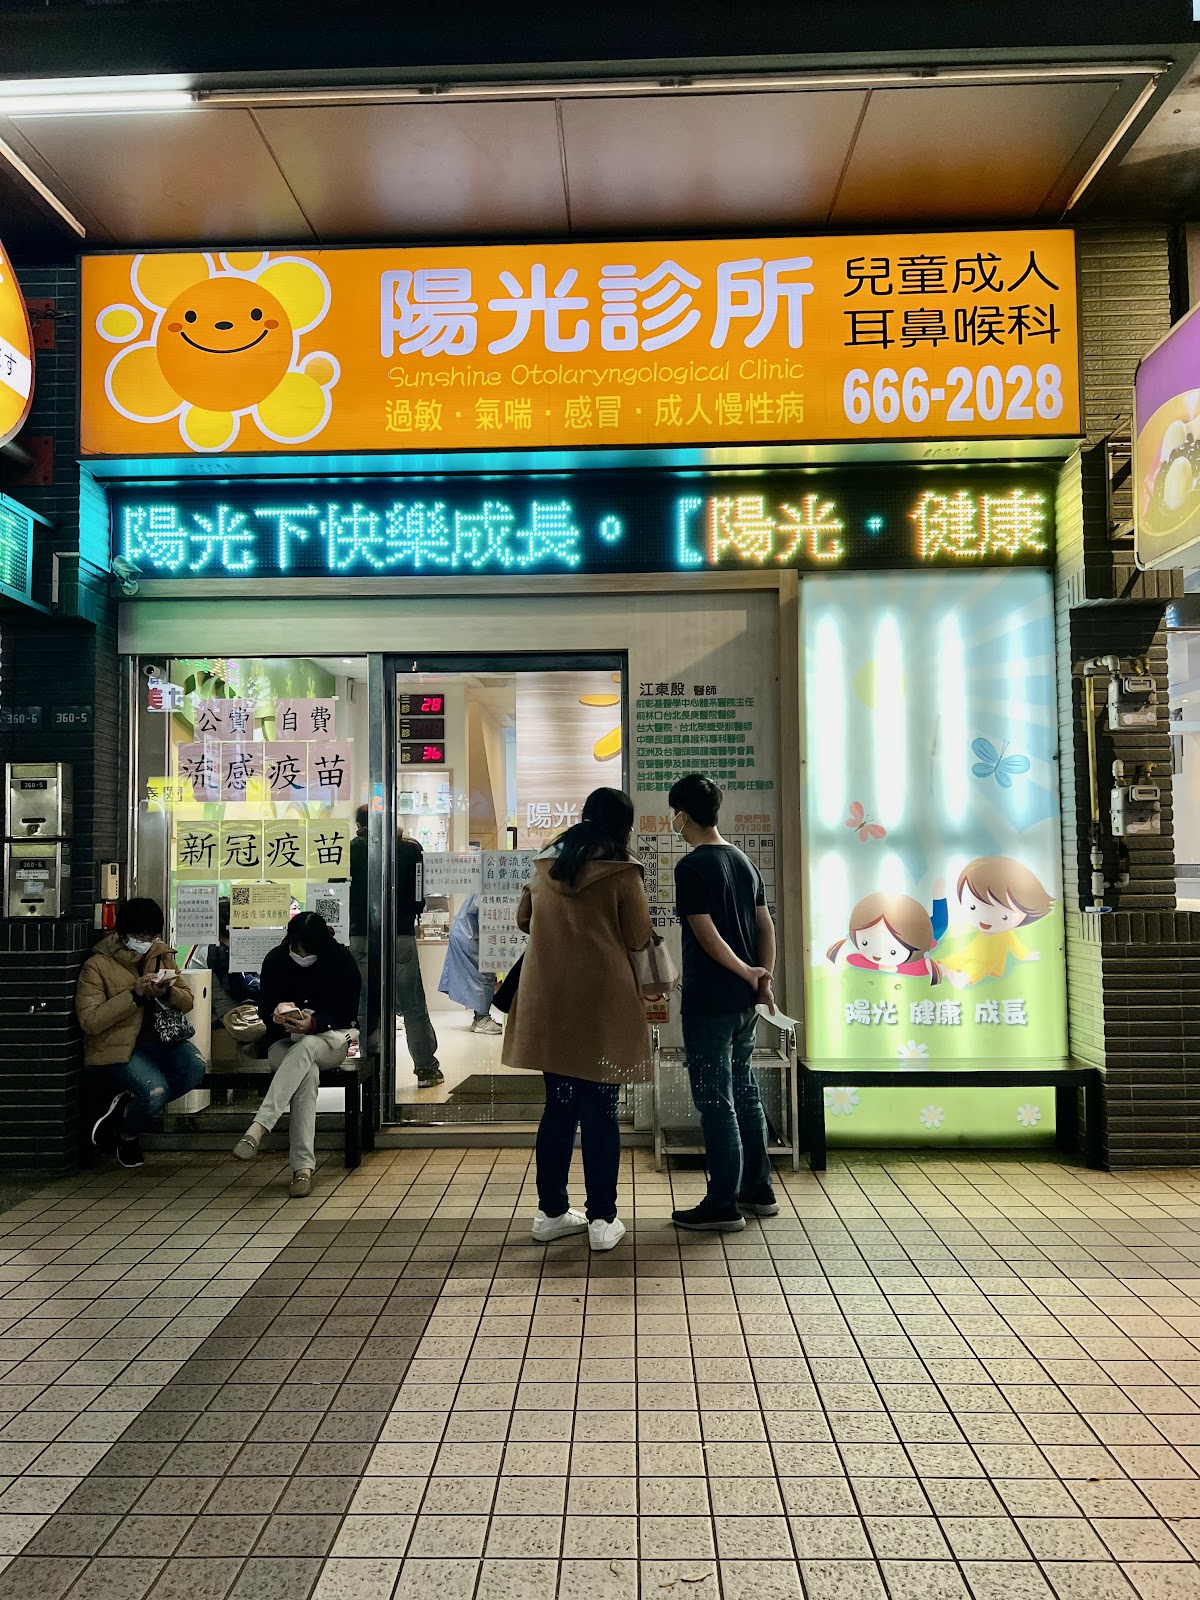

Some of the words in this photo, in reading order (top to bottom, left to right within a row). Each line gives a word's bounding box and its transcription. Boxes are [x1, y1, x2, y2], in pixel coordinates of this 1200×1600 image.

[843, 250, 1060, 298] 兒童成人
[380, 256, 814, 358] 陽光診所
[843, 304, 1061, 350] 耳鼻喉科
[389, 366, 501, 387] Sunshine
[511, 359, 729, 386] Otolaryngological
[739, 358, 804, 380] Clinic
[842, 363, 1063, 425] 666-2028
[693, 685, 717, 696] 醫師
[56, 713, 87, 723] 360-5
[421, 698, 442, 713] 28
[198, 707, 250, 735] 公費
[281, 706, 332, 734] 自費
[422, 745, 442, 761] 36
[182, 753, 346, 790] 流感疫苗
[179, 831, 347, 868] 新冠疫苗
[844, 1000, 898, 1026] 陽光
[909, 1000, 962, 1026] 健康
[974, 999, 1028, 1027] 成長
